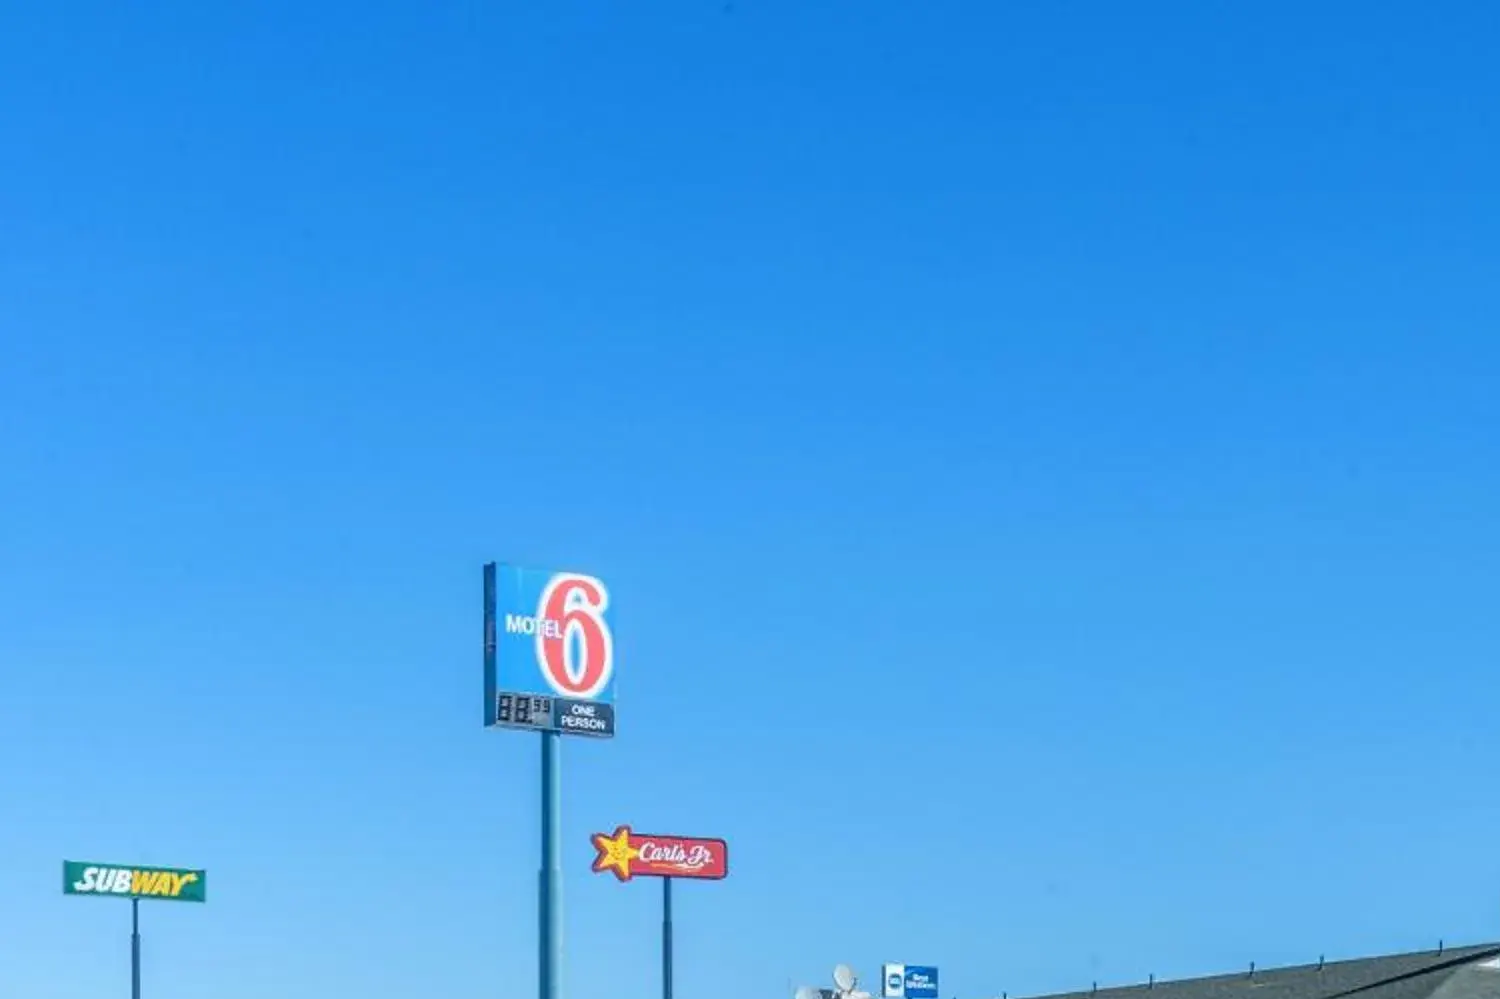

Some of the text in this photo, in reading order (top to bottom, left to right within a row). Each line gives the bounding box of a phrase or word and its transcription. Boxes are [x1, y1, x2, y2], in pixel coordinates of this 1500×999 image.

[505, 572, 614, 698] MOTEL 6
[571, 704, 596, 717] ONE
[561, 716, 606, 730] PERSON
[73, 866, 199, 897] SUBWAY
